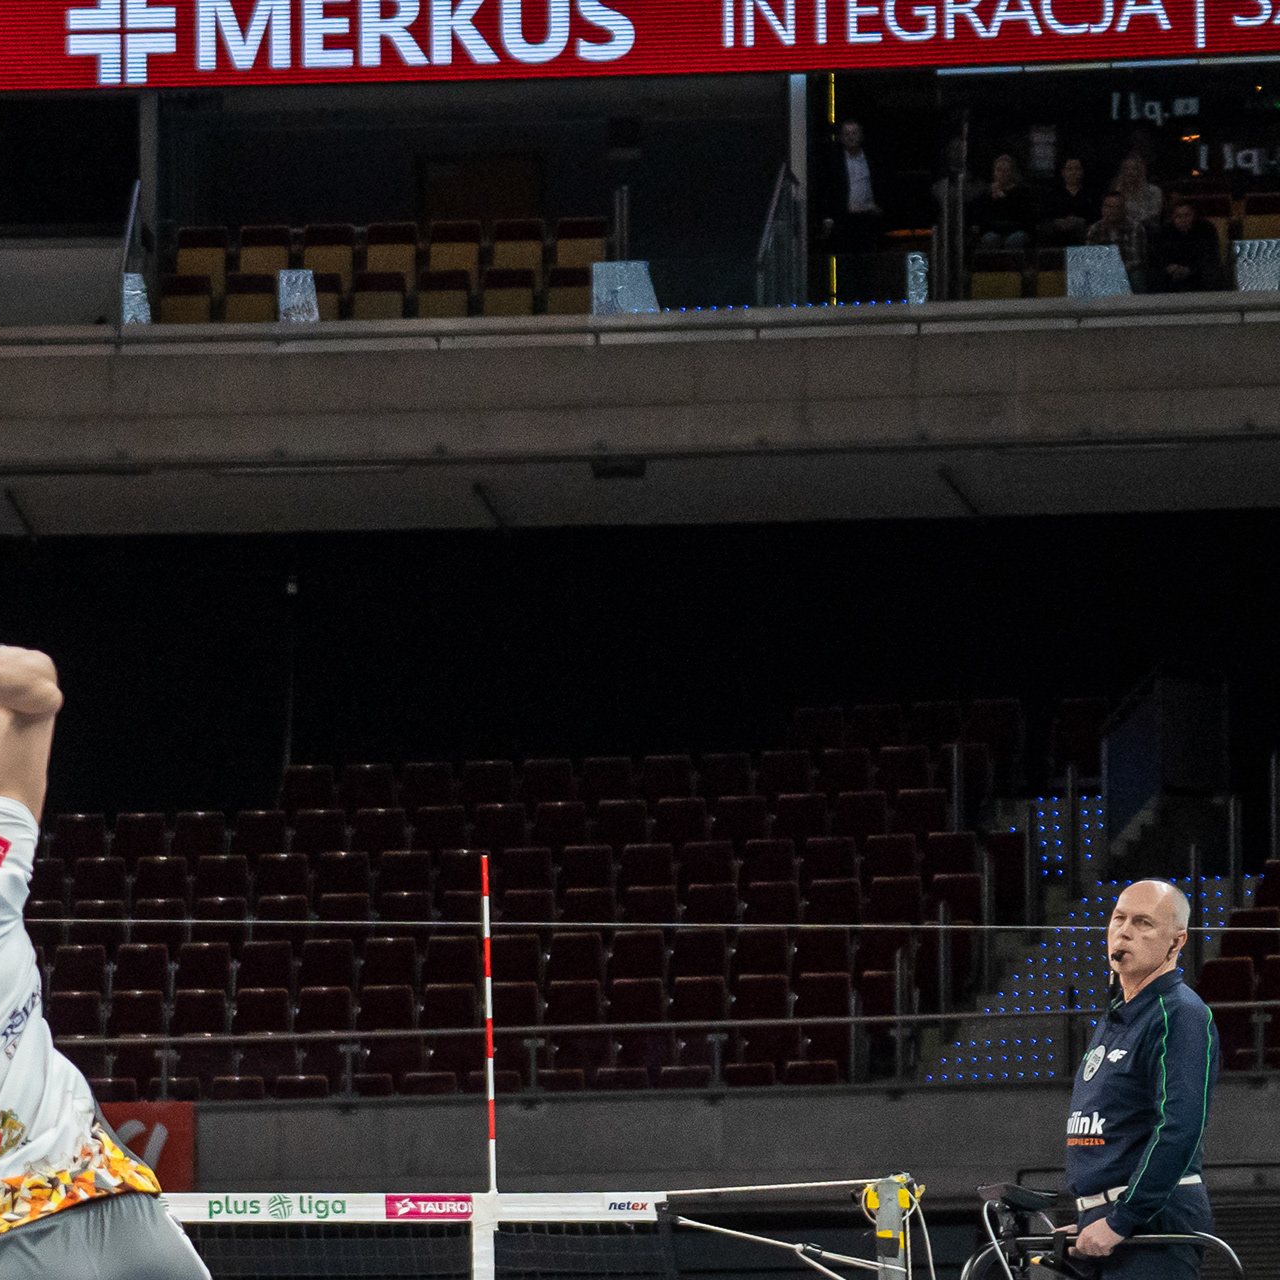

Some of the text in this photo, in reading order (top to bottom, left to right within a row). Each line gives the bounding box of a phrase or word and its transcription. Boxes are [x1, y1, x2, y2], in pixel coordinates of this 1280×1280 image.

[194, 0, 637, 71] MERKUS
[722, 0, 1172, 48] INTEGRACJA
[208, 1194, 347, 1218] plus liga
[608, 1200, 649, 1212] netex
